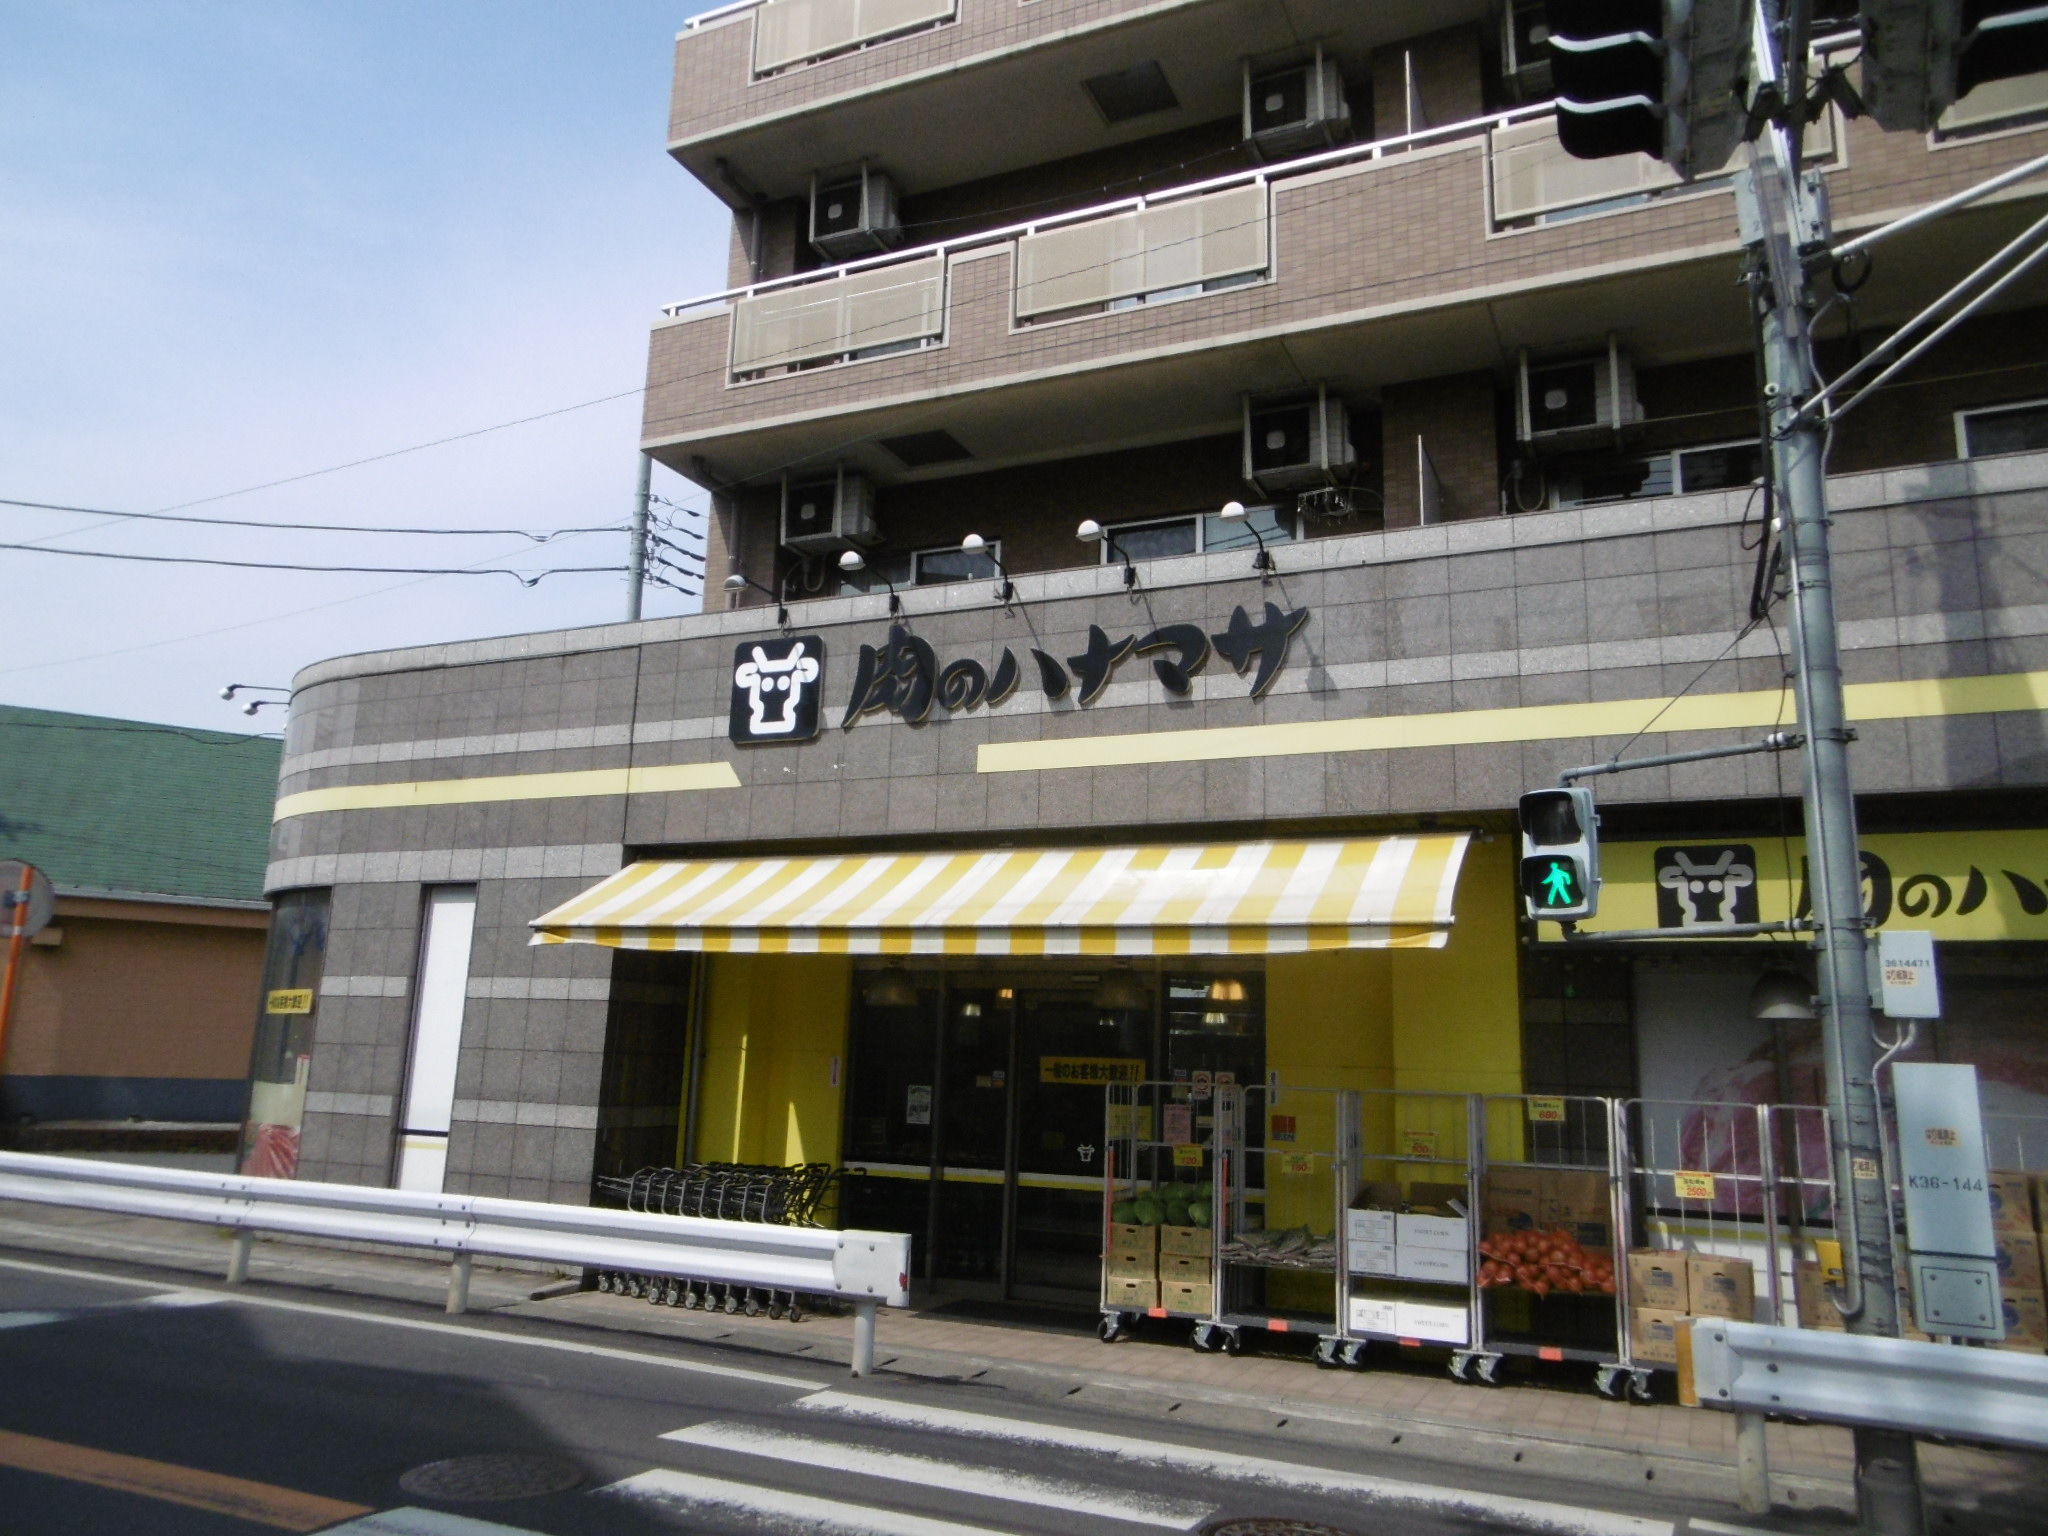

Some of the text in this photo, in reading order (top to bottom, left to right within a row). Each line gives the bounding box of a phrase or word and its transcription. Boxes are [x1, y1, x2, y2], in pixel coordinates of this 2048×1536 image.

[841, 600, 1309, 728] 肉のハナマサ
[1908, 1175, 1983, 1191] K36-144
